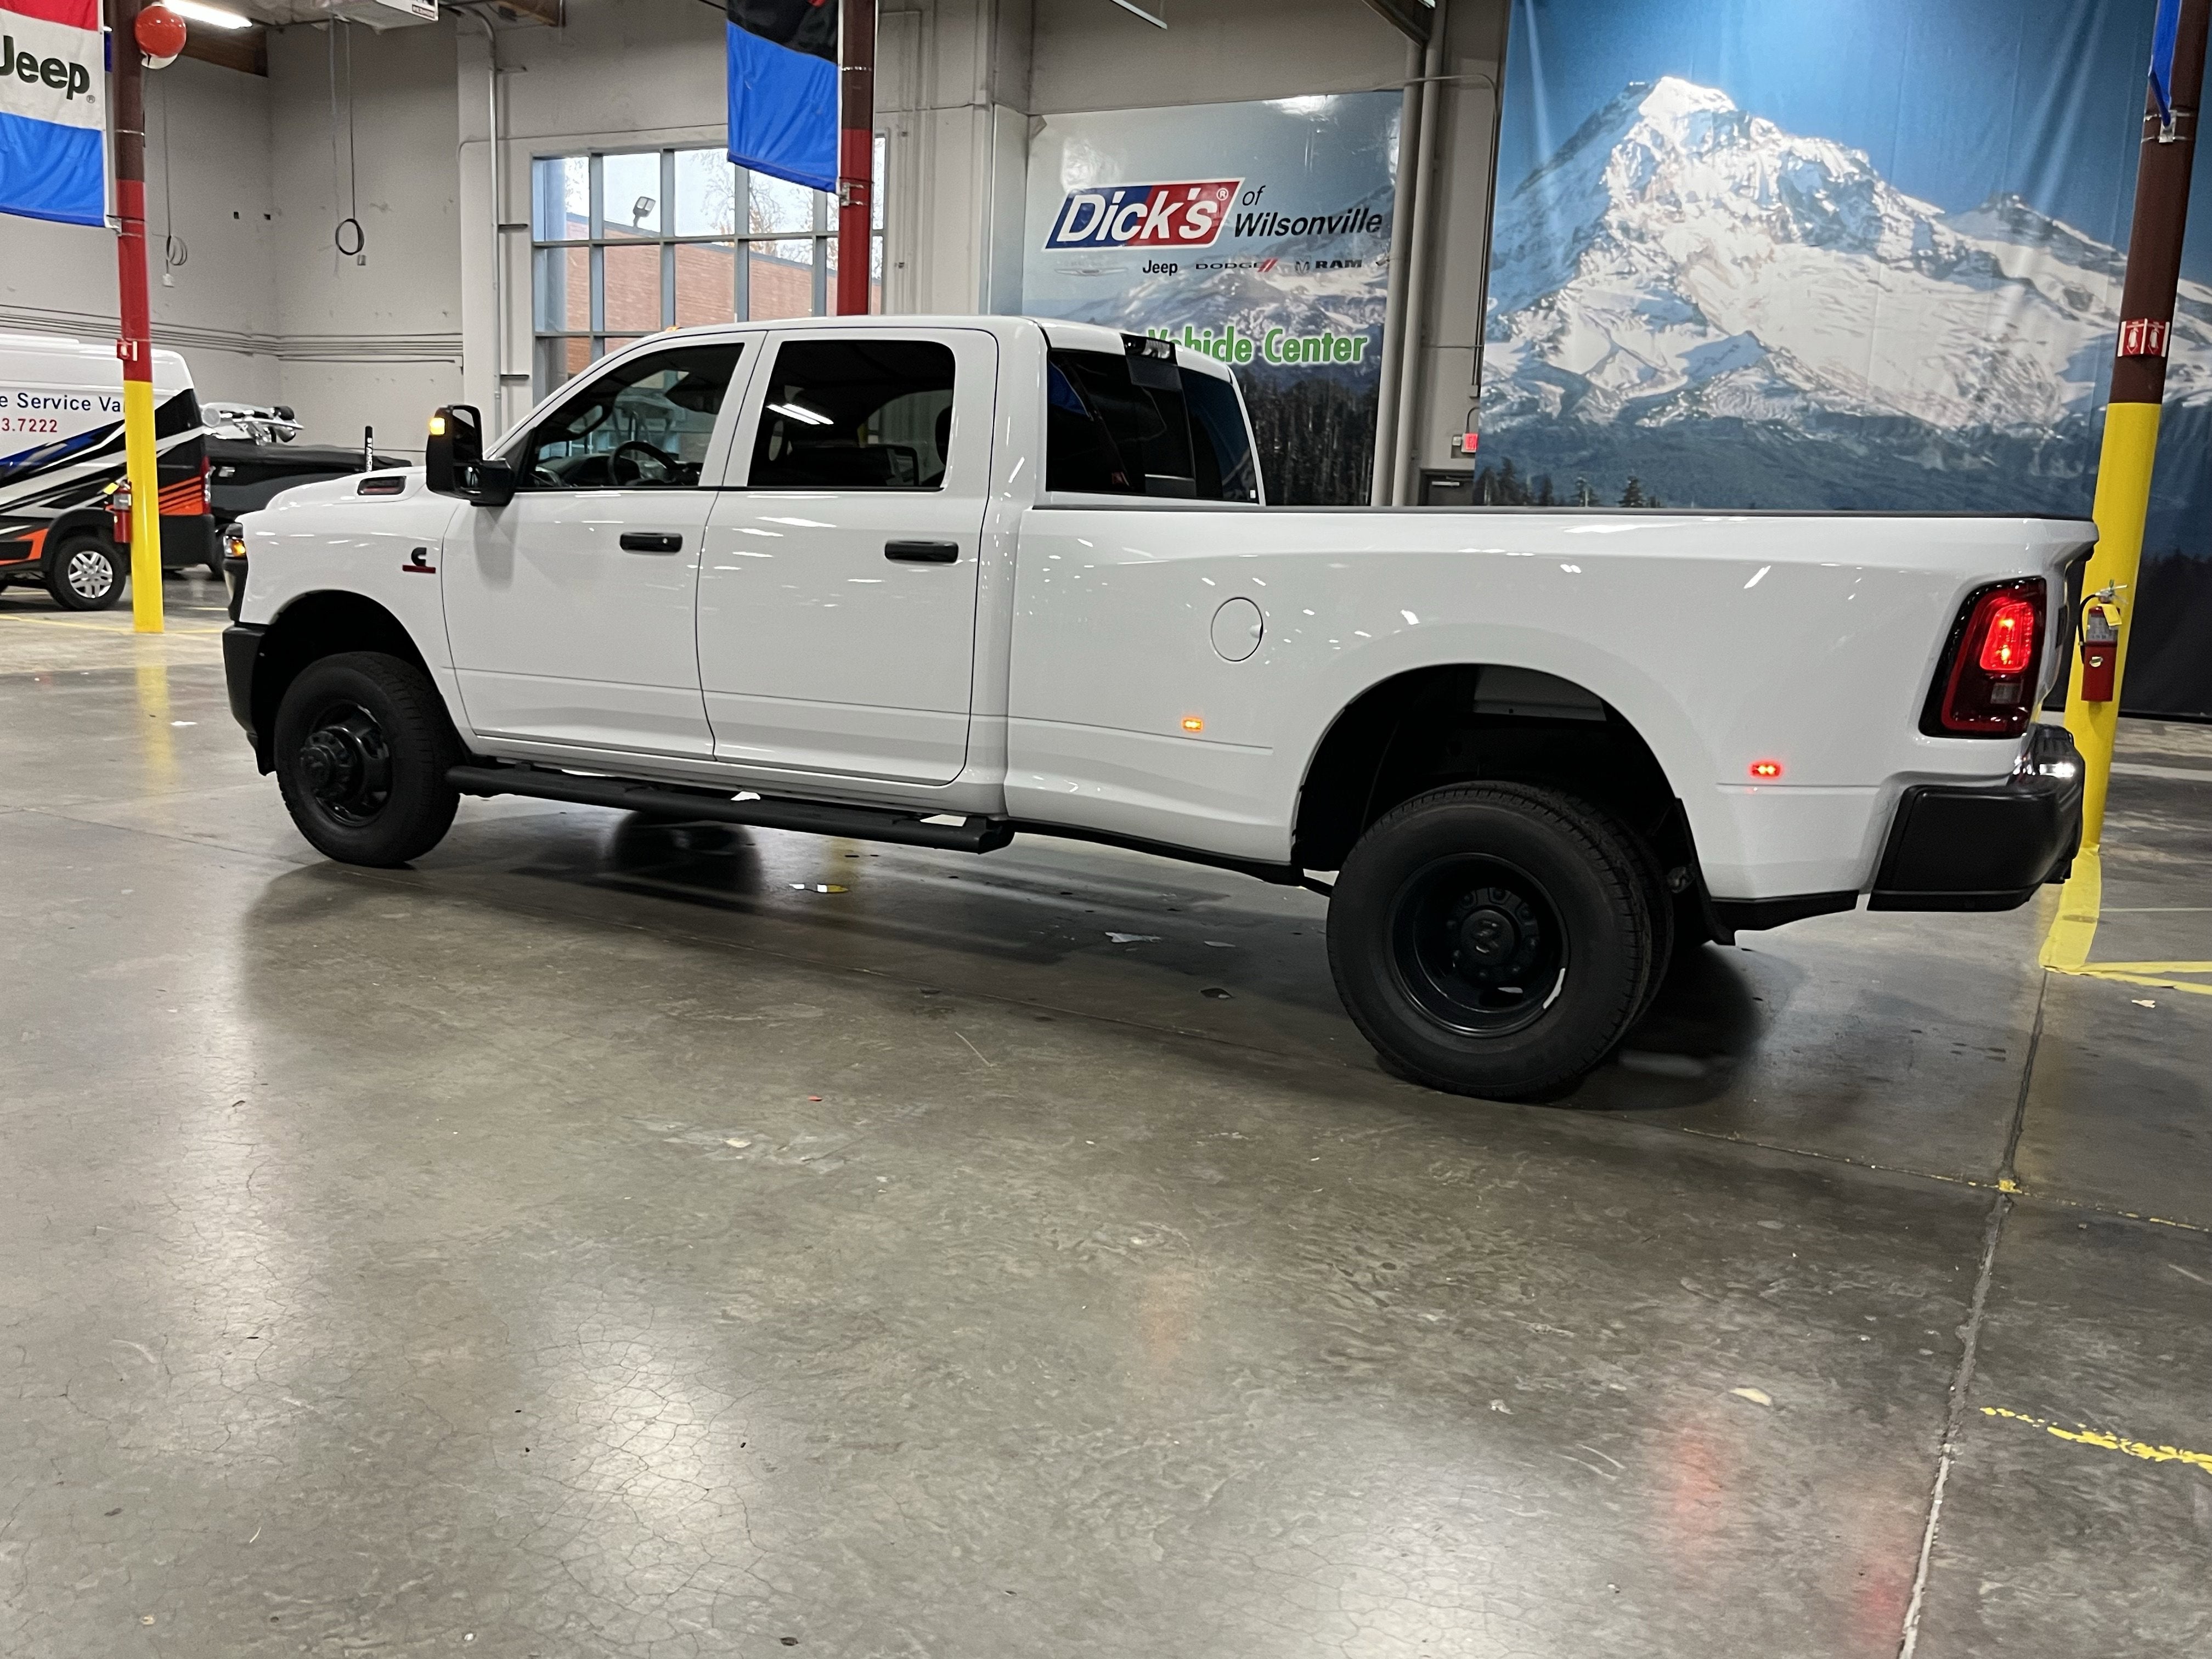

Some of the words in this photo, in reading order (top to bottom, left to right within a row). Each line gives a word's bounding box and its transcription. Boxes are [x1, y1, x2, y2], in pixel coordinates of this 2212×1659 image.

[0, 35, 90, 100] Jeep
[1242, 185, 1266, 206] of
[1234, 208, 1383, 238] Wilsonville
[1142, 260, 1178, 276] Jeep
[1316, 259, 1362, 268] RAM
[1265, 329, 1368, 362] Center
[17, 393, 91, 411] Service
[99, 396, 125, 413] Va
